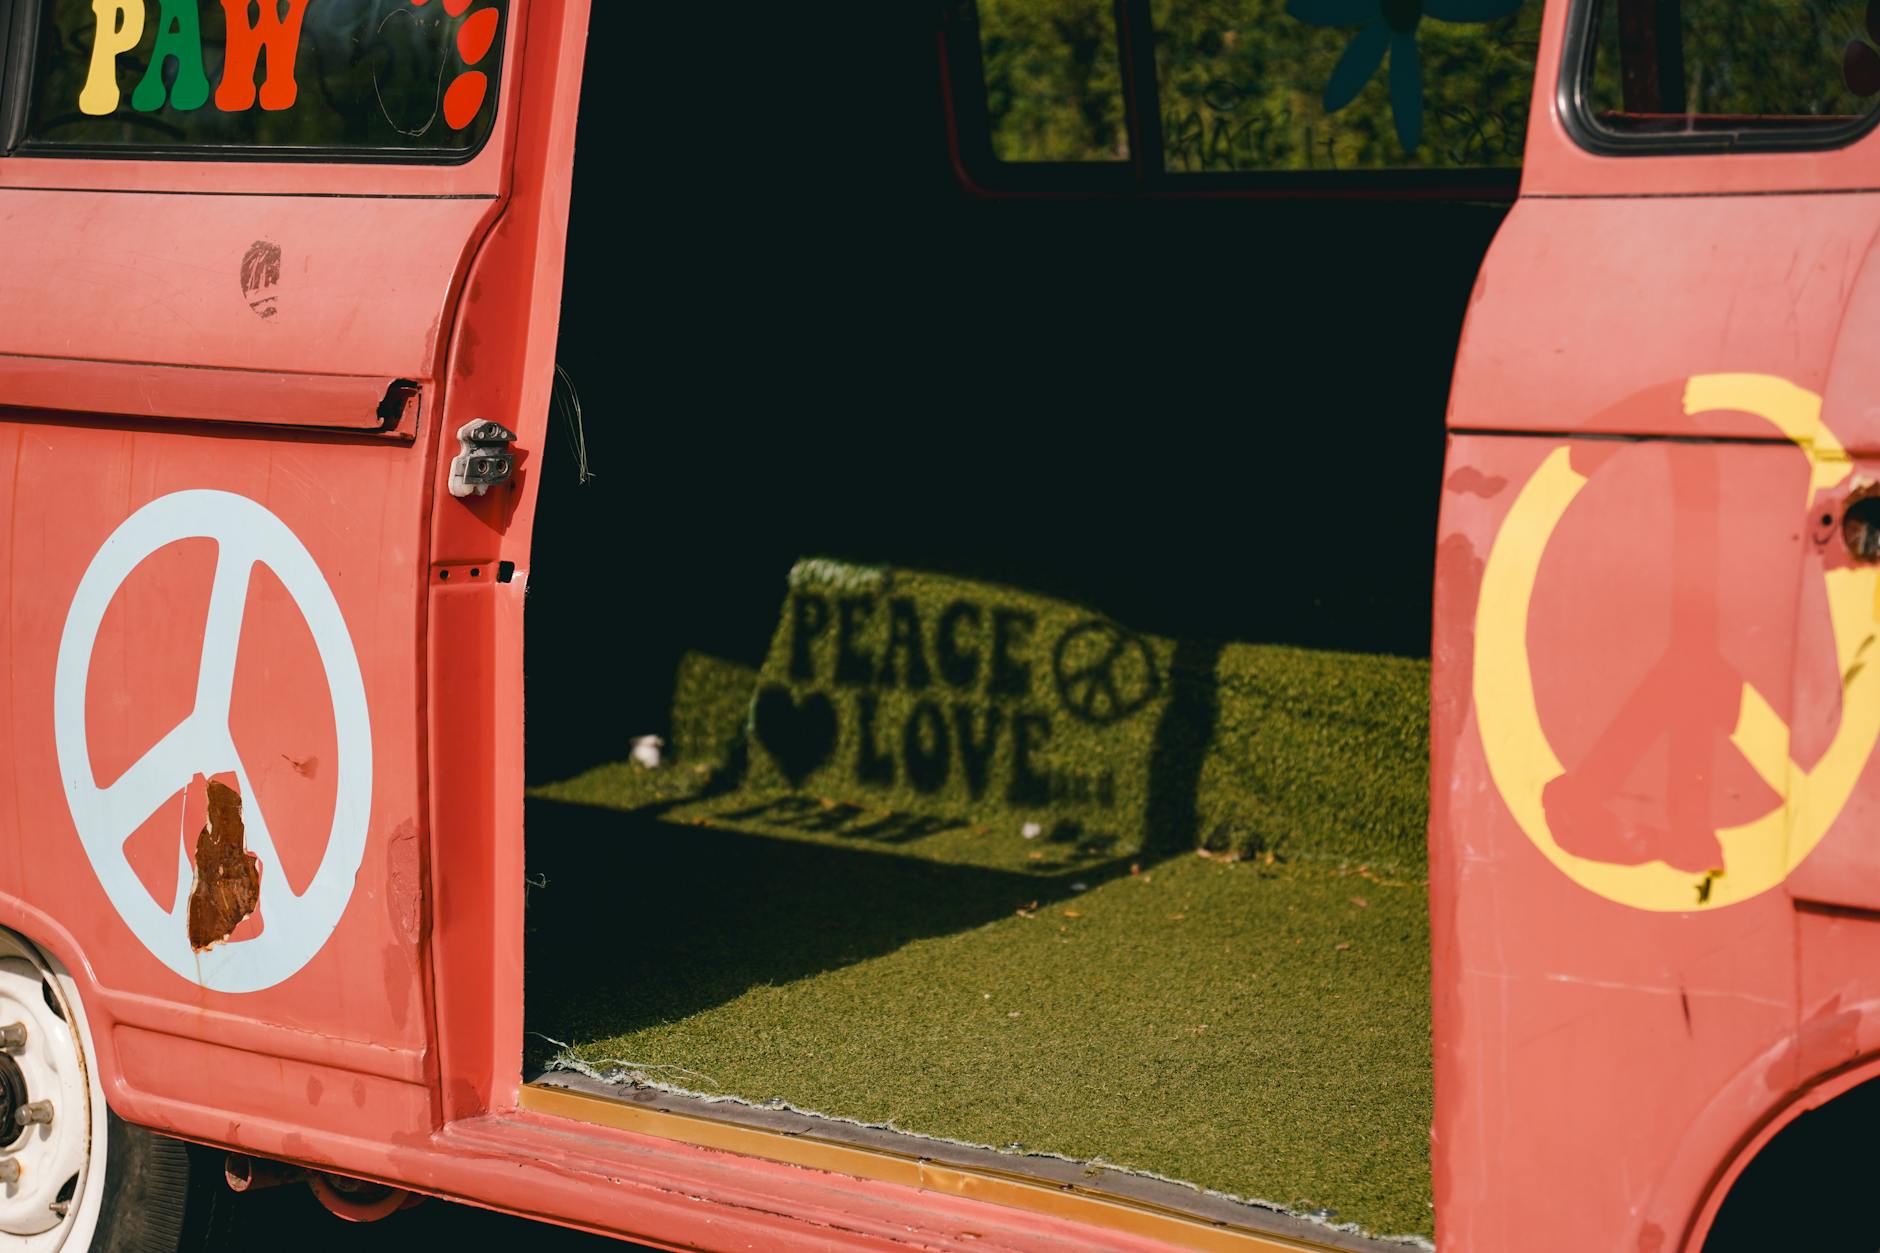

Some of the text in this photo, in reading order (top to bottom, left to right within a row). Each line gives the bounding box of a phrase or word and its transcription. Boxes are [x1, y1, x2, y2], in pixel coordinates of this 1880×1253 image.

[78, 0, 308, 115] PAW
[789, 593, 1035, 697] PEACE
[857, 692, 1050, 807] LOVE
